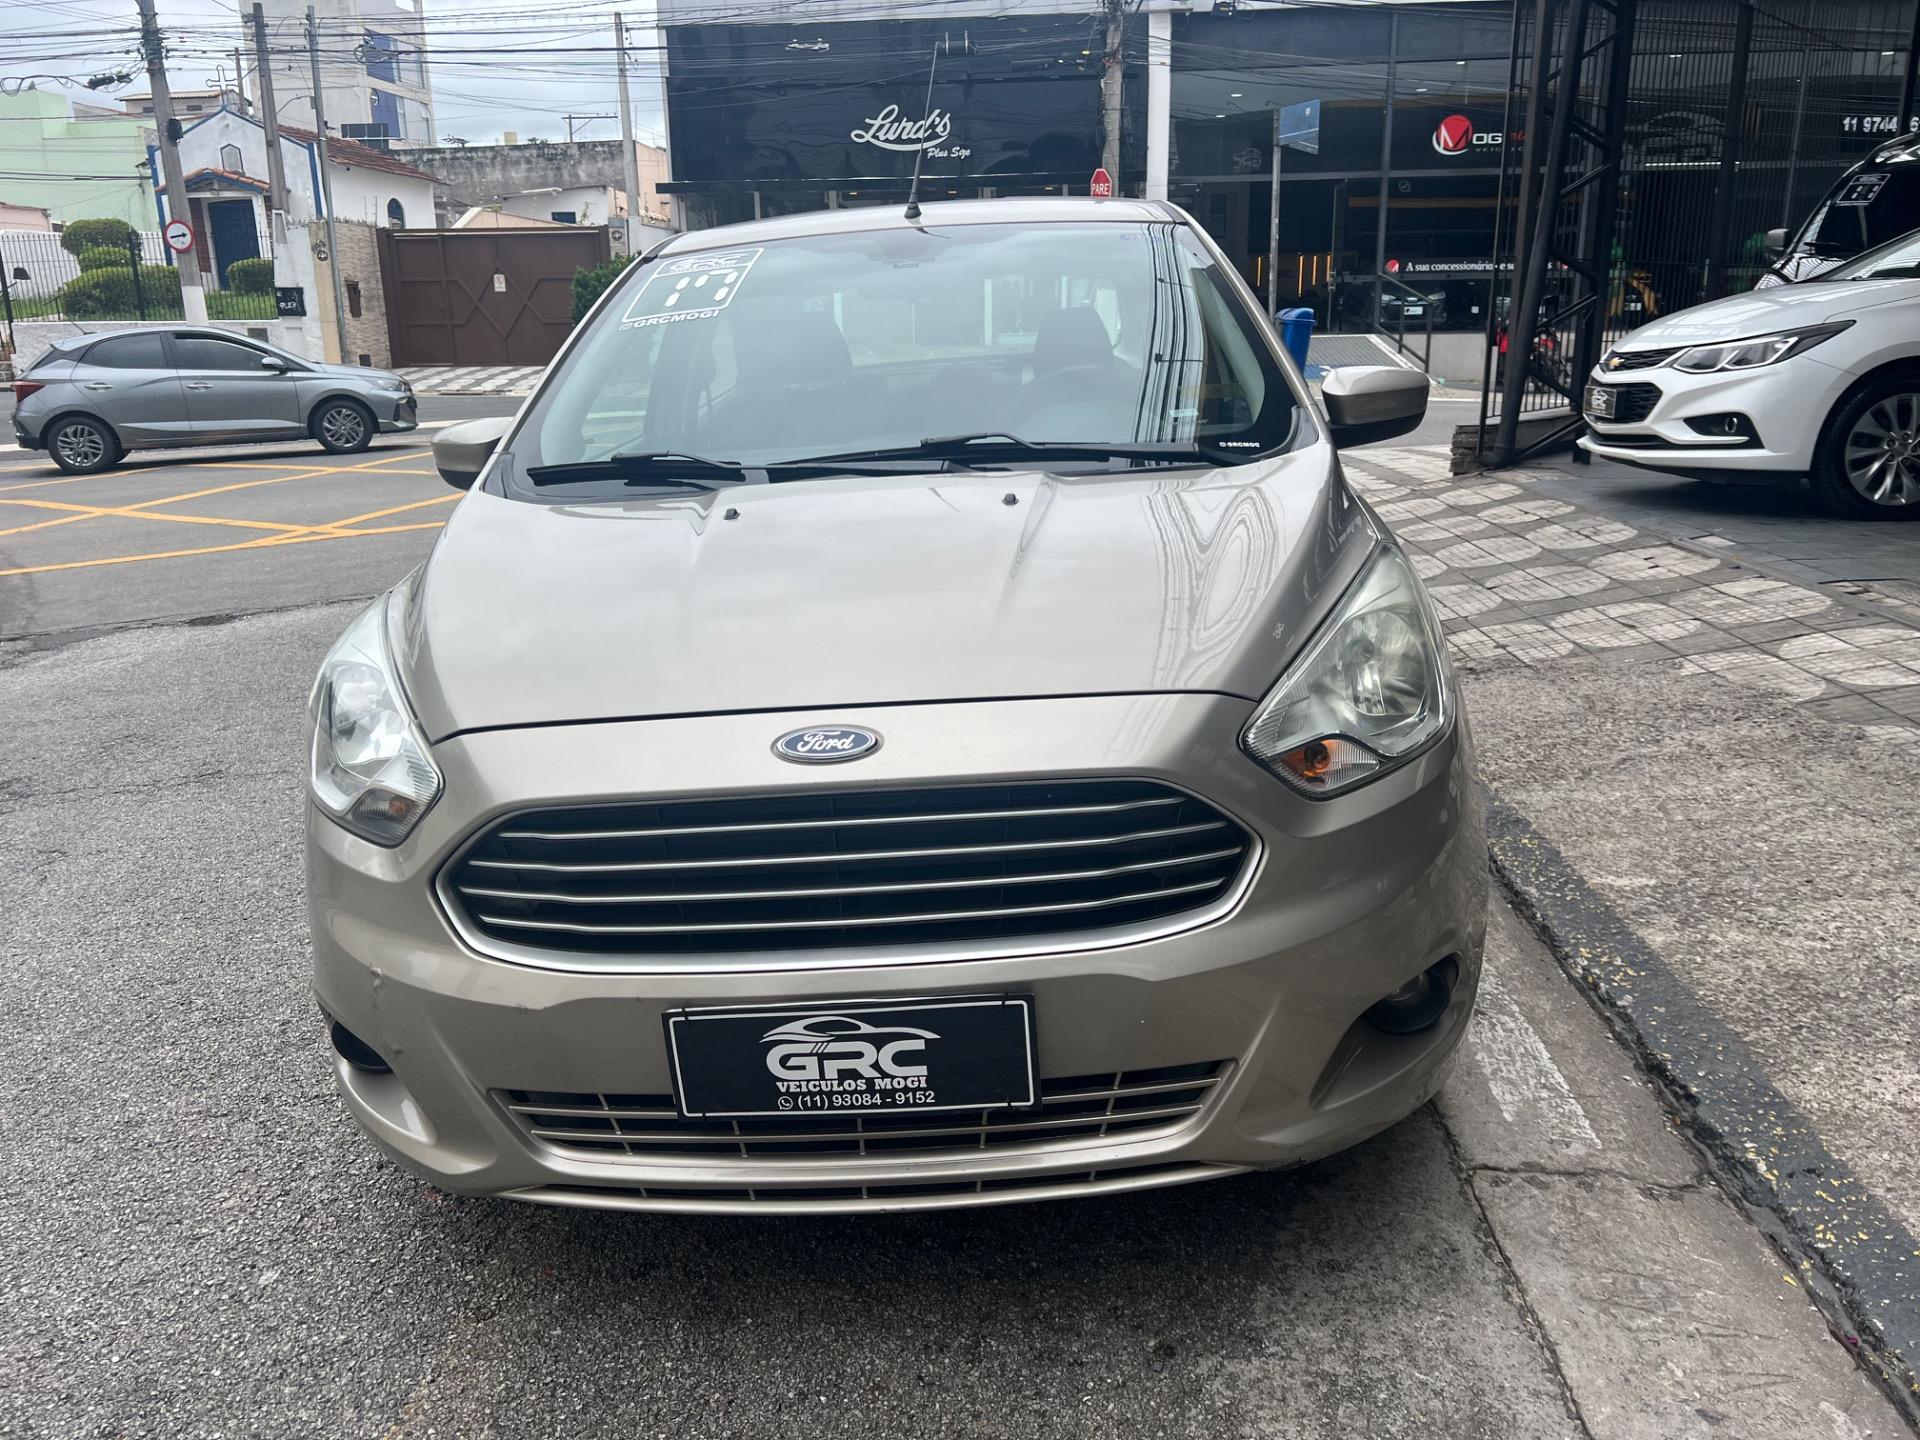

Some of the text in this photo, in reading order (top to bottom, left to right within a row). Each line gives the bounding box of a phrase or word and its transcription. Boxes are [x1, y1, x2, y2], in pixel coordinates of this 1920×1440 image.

[1842, 116, 1858, 131] 11
[1862, 116, 1903, 133] 9744
[927, 148, 948, 159] Plus
[1091, 183, 1110, 195] PARE
[1405, 262, 1413, 271] A
[1430, 261, 1493, 271] concessionária
[797, 730, 856, 752] Ford
[766, 1039, 928, 1080] GRC
[776, 1076, 928, 1092] VEICULOS MOGI
[798, 1094, 829, 1110] (11)
[832, 1093, 882, 1106] 93084
[895, 1091, 935, 1104] 9152
